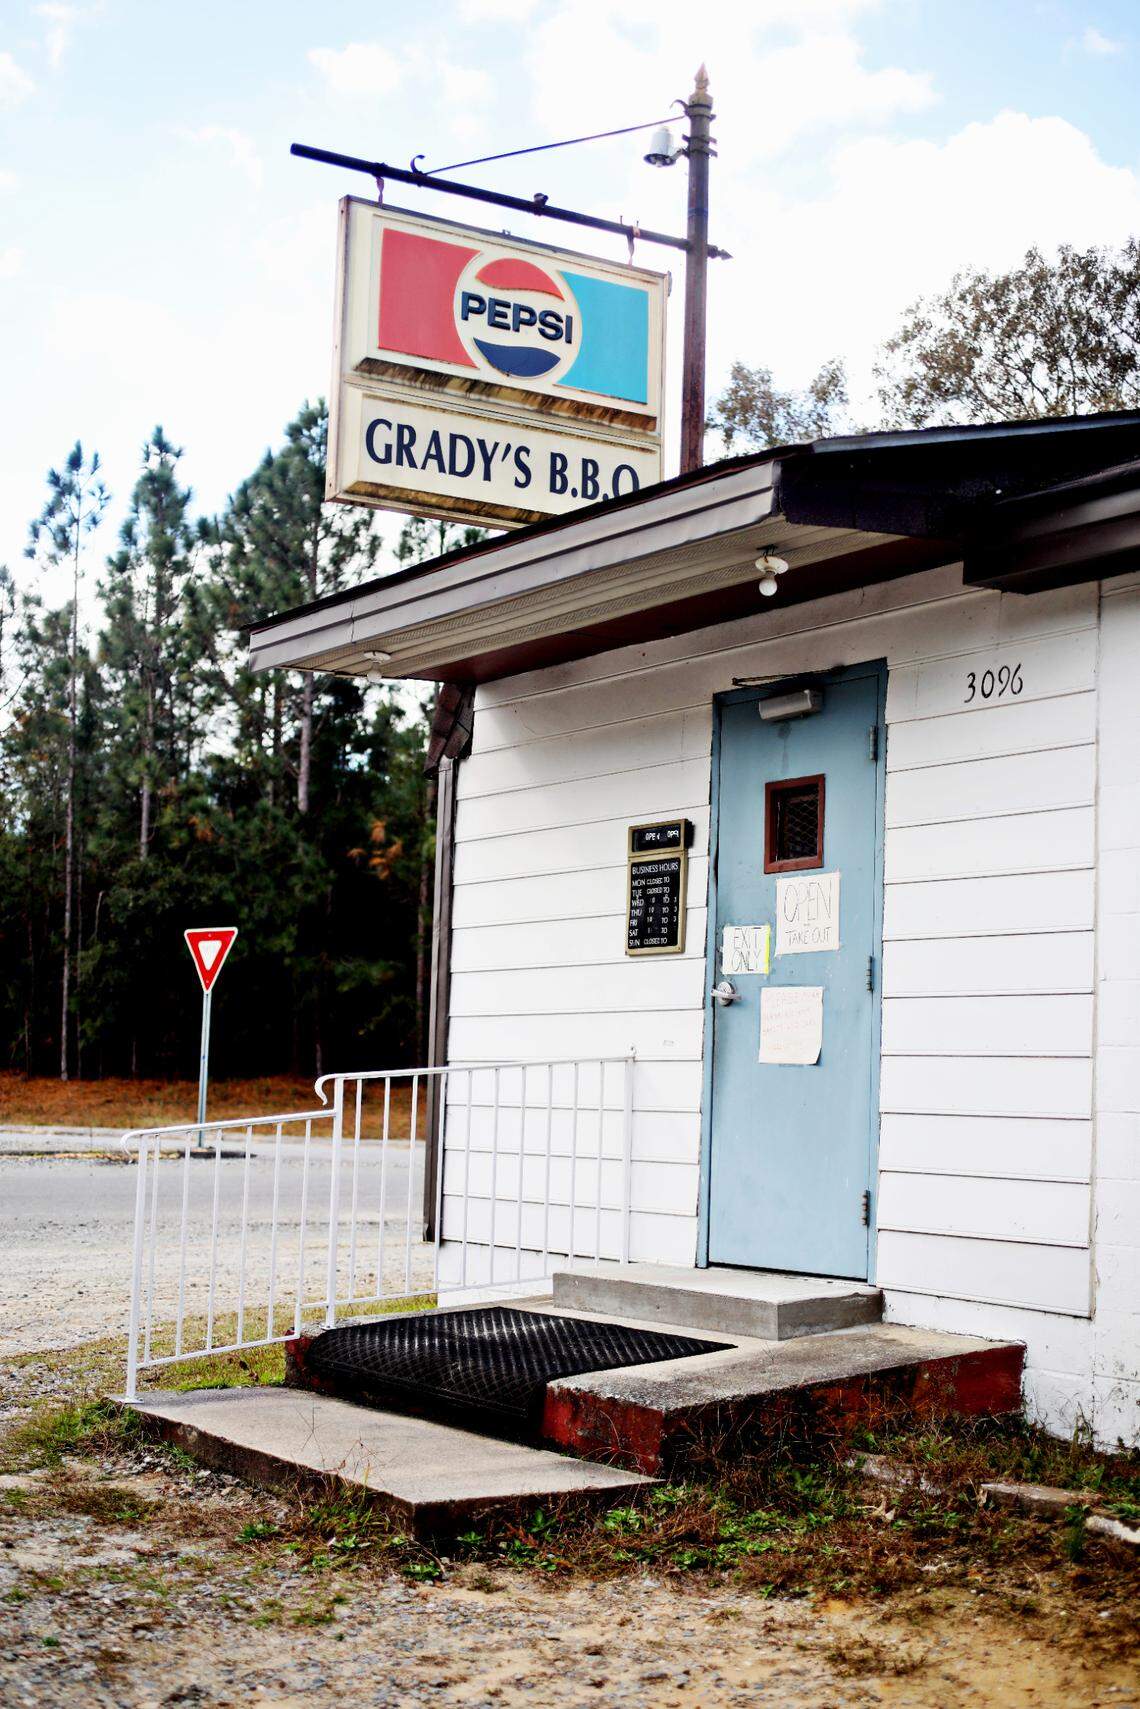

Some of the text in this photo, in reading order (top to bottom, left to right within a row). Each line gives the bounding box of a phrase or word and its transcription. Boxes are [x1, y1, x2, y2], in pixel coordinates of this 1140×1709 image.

[460, 291, 574, 345] PEPSI
[365, 418, 532, 489] GRADY'S
[964, 663, 1024, 704] 3096
[632, 861, 679, 875] BUSINESS HOURS
[632, 879, 646, 888] MON
[663, 876, 670, 884] TO
[632, 889, 643, 897] TUE
[663, 886, 670, 894] TO
[631, 898, 645, 907] WED
[784, 880, 833, 923] OPEN
[631, 908, 643, 917] THU
[662, 906, 670, 914] TO
[630, 919, 638, 927] FRI
[661, 916, 669, 924] TO
[628, 928, 639, 937] SAT
[733, 927, 762, 950] EXIT
[785, 926, 832, 947] TAKE OUT
[628, 938, 641, 947] SUN
[660, 937, 668, 945] TO
[731, 948, 762, 972] ONLY
